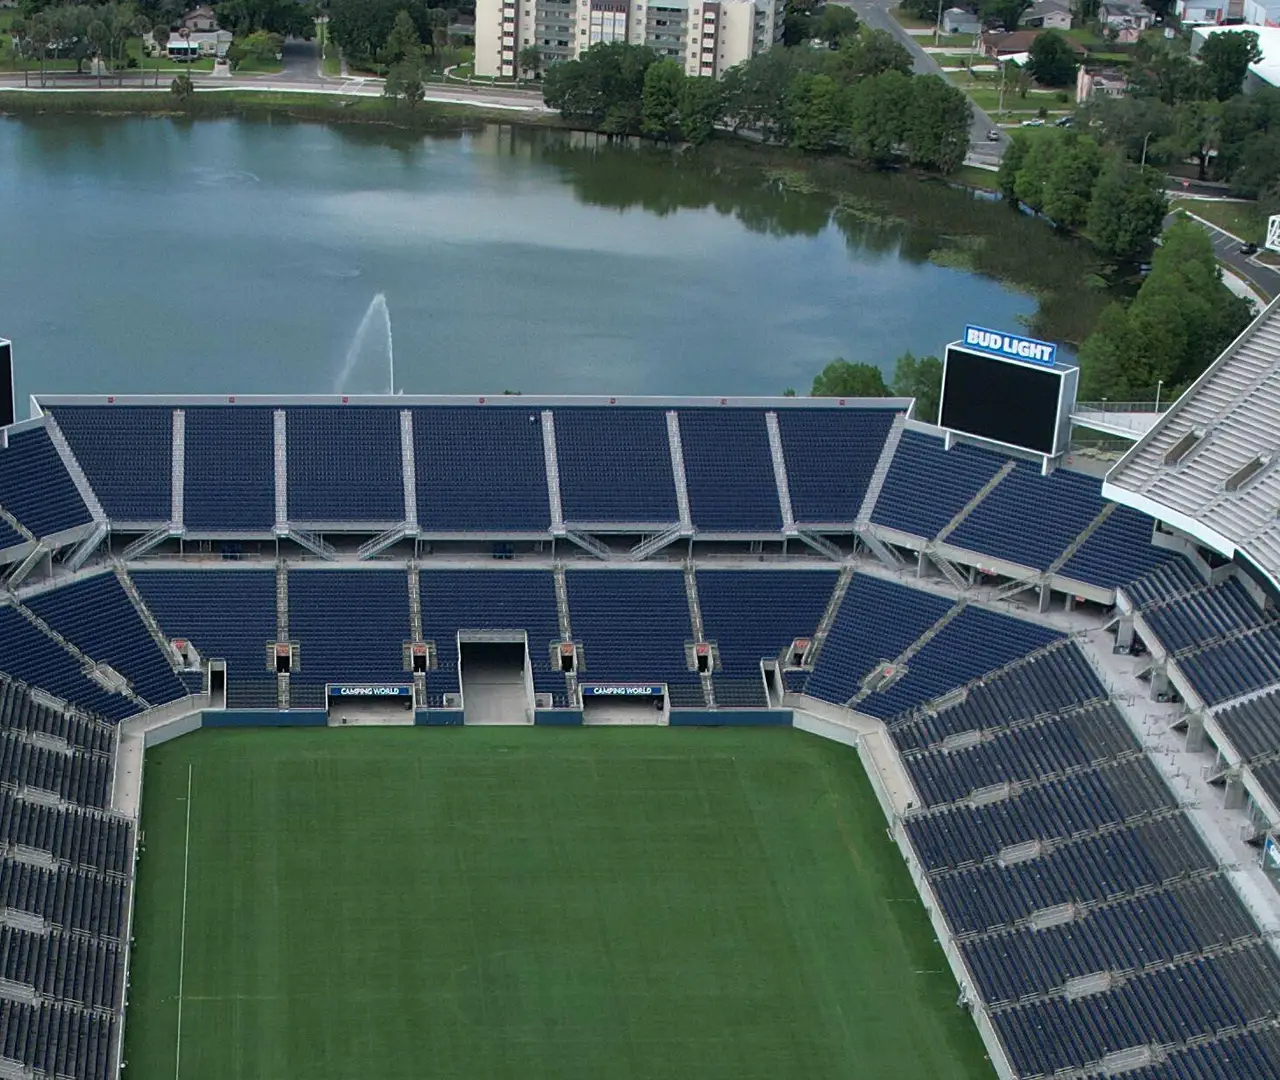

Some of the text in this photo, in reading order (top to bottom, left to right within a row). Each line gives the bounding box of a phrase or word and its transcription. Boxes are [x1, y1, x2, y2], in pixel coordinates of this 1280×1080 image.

[966, 328, 1053, 362] BUD LIGHT
[340, 687, 400, 695] CAMPING WORLD
[593, 686, 652, 695] CAMPING WORLD
